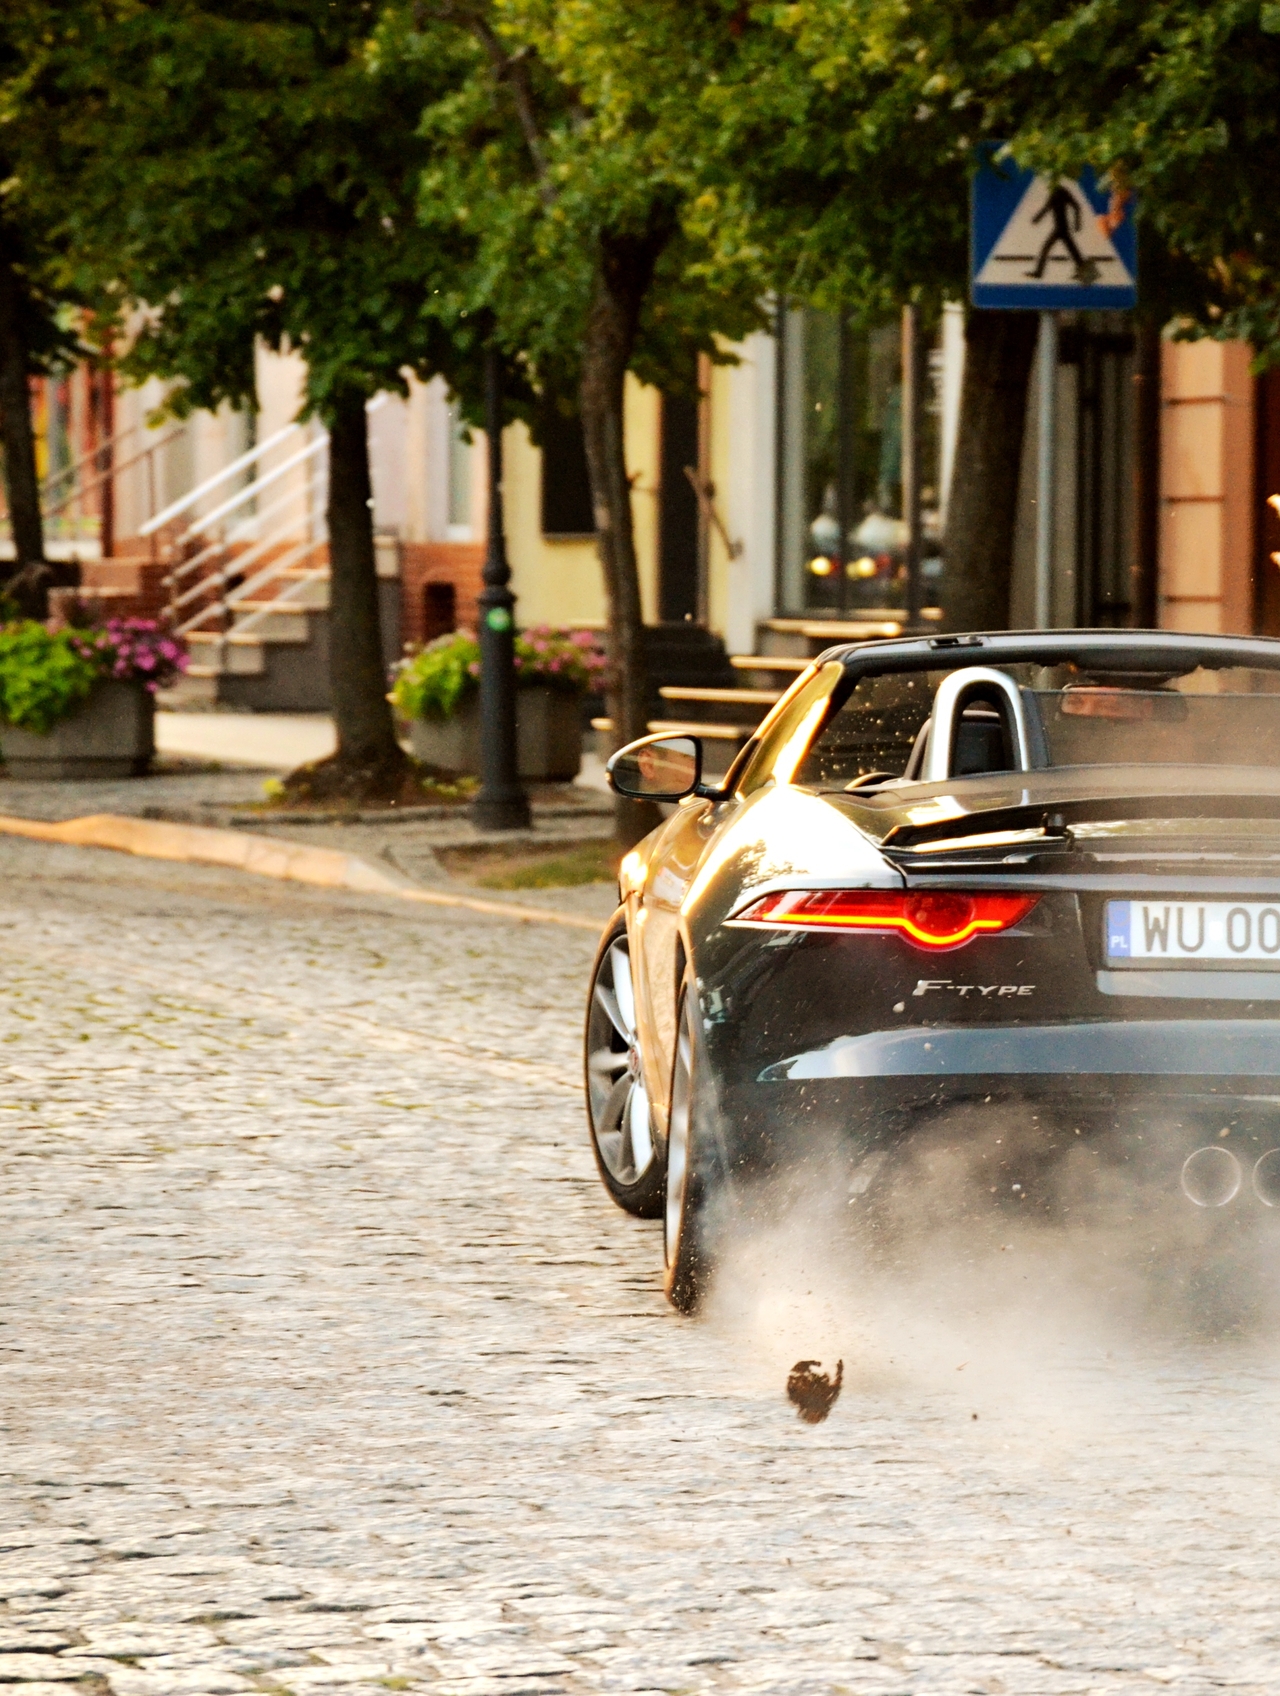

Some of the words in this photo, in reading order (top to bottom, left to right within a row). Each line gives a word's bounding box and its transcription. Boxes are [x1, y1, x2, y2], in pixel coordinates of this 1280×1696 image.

[1142, 905, 1206, 953] WU
[1110, 934, 1129, 949] PL
[911, 979, 1037, 997] F-TYPE
